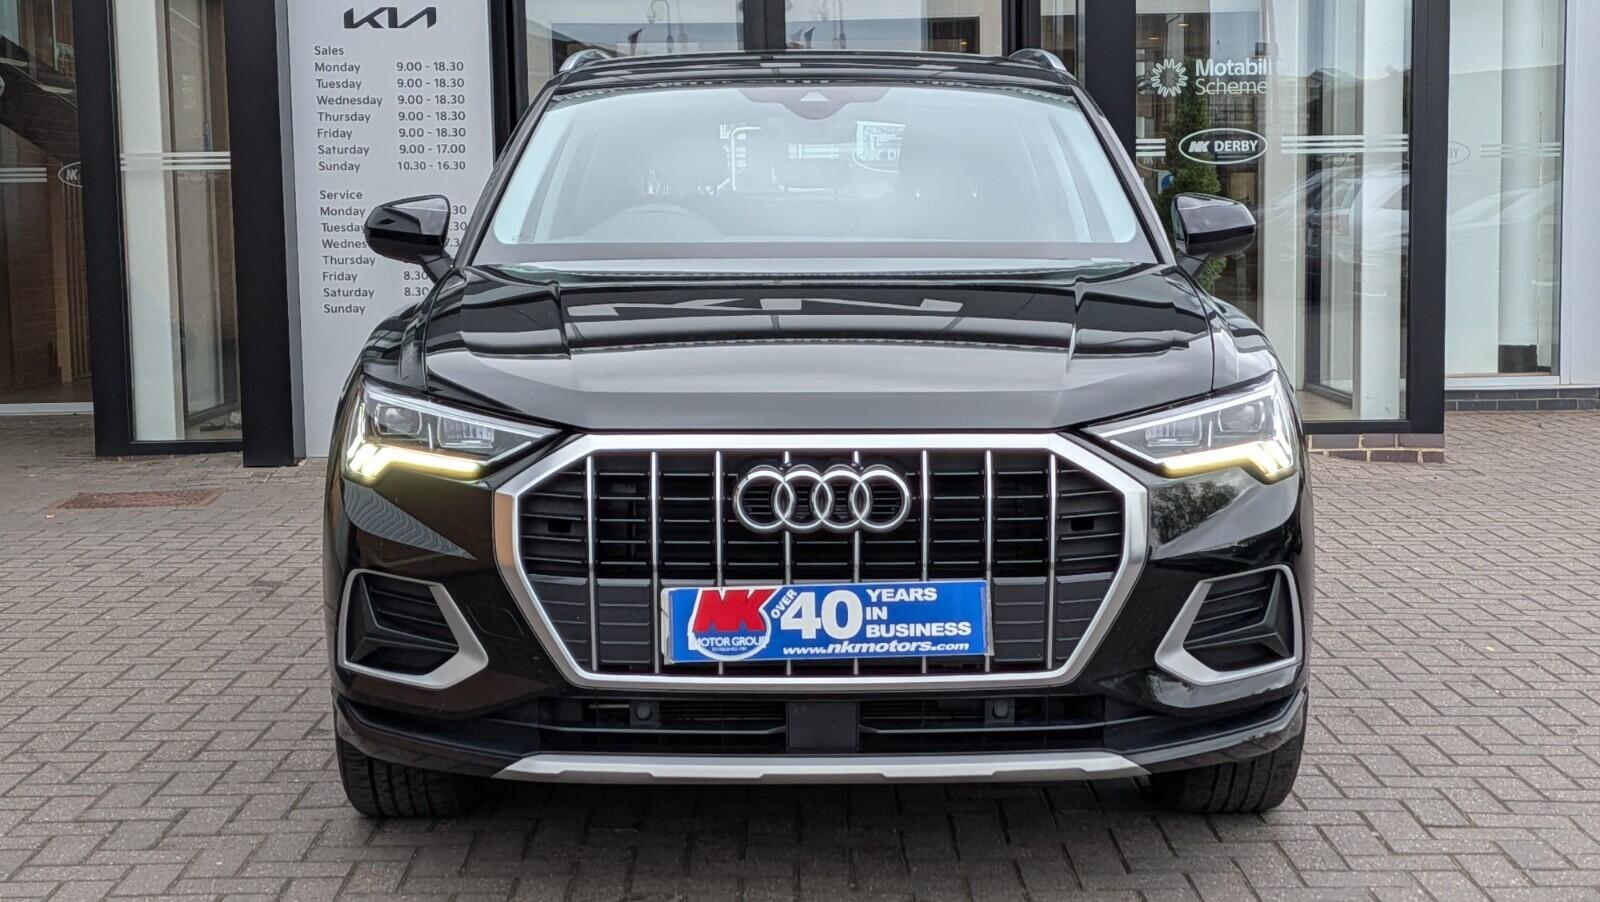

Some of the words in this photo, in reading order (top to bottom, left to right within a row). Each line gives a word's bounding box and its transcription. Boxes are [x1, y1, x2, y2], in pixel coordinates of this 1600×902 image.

[314, 46, 345, 56] Sales
[314, 62, 361, 75] Monday
[396, 61, 423, 72] 9.00
[433, 61, 464, 72] 18.30
[316, 78, 362, 91] Tuesday
[397, 78, 423, 88] 9.00
[434, 78, 465, 88] 18.30
[1194, 78, 1269, 95] Scheme
[316, 95, 383, 108] Wednesday
[397, 95, 424, 105] 9.00
[434, 94, 465, 105] 18.30
[317, 111, 372, 124] Thursday
[398, 111, 424, 121] 9.00
[435, 111, 466, 121] 18.30
[317, 127, 353, 141] Friday
[398, 128, 425, 138] 9.00
[435, 127, 466, 138] 18.30
[318, 144, 370, 157] Saturday
[399, 144, 425, 154] 9.00
[436, 143, 466, 154] 17.00
[1214, 140, 1258, 152] DERBY
[319, 160, 361, 174] Sunday
[398, 161, 426, 171] 10.30
[437, 160, 466, 171] 16.30
[319, 189, 363, 200] Service
[319, 206, 366, 218] Monday
[322, 239, 369, 249] Wednes
[322, 255, 376, 267] Thursday
[322, 271, 358, 284] Friday
[403, 270, 428, 281] 8.30
[323, 287, 375, 300] Saturday
[324, 303, 366, 316] Sunday
[866, 588, 938, 602] YEARS
[692, 588, 776, 633] NK
[770, 588, 798, 620] OVER
[780, 589, 864, 640] 40
[866, 606, 888, 620] IN
[865, 622, 971, 638] BUSINESS
[783, 639, 970, 655] www.nkmotors.com
